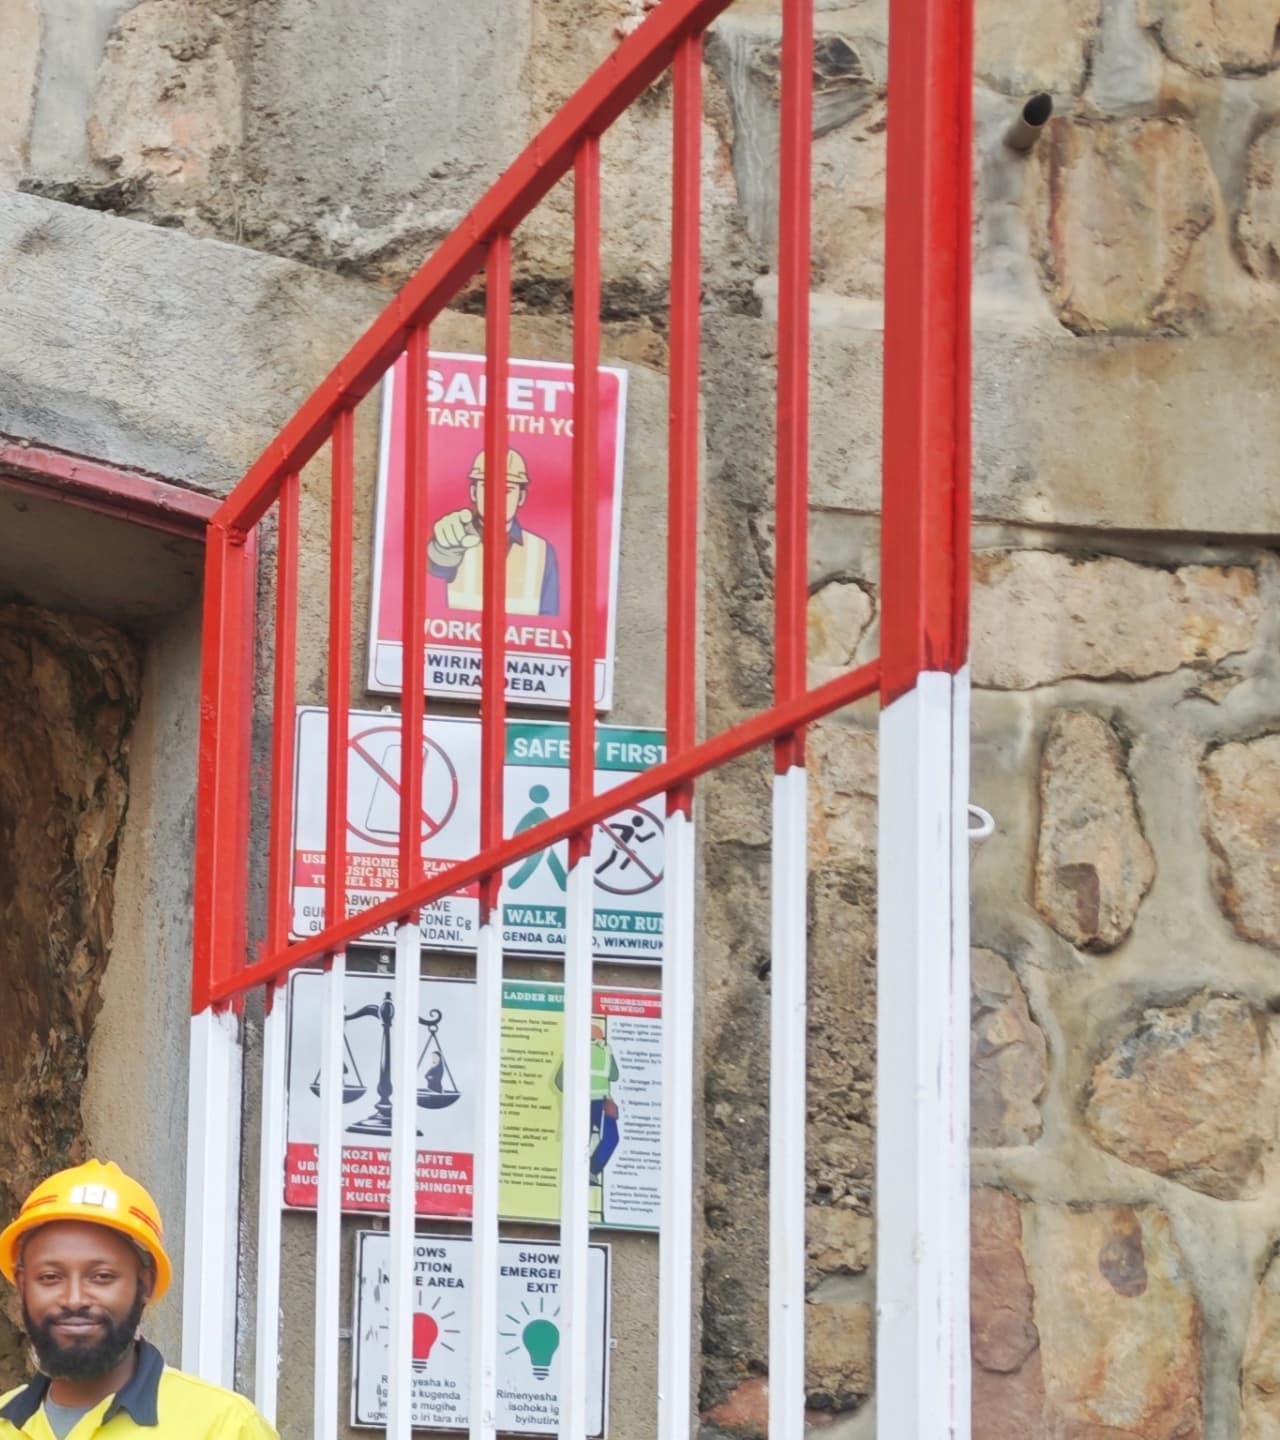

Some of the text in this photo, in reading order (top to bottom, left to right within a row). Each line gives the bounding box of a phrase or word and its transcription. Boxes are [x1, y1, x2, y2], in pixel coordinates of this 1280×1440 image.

[427, 407, 484, 429] TART
[508, 414, 544, 434] ITH
[425, 618, 481, 641] ORK
[505, 625, 572, 649] AFELY
[506, 908, 663, 932] WALK, NOT RU
[502, 931, 543, 943] GENDA
[354, 1178, 372, 1188] WE
[519, 1252, 559, 1264] SHOW
[428, 1277, 465, 1289] AREA
[527, 1282, 559, 1294] EXIT
